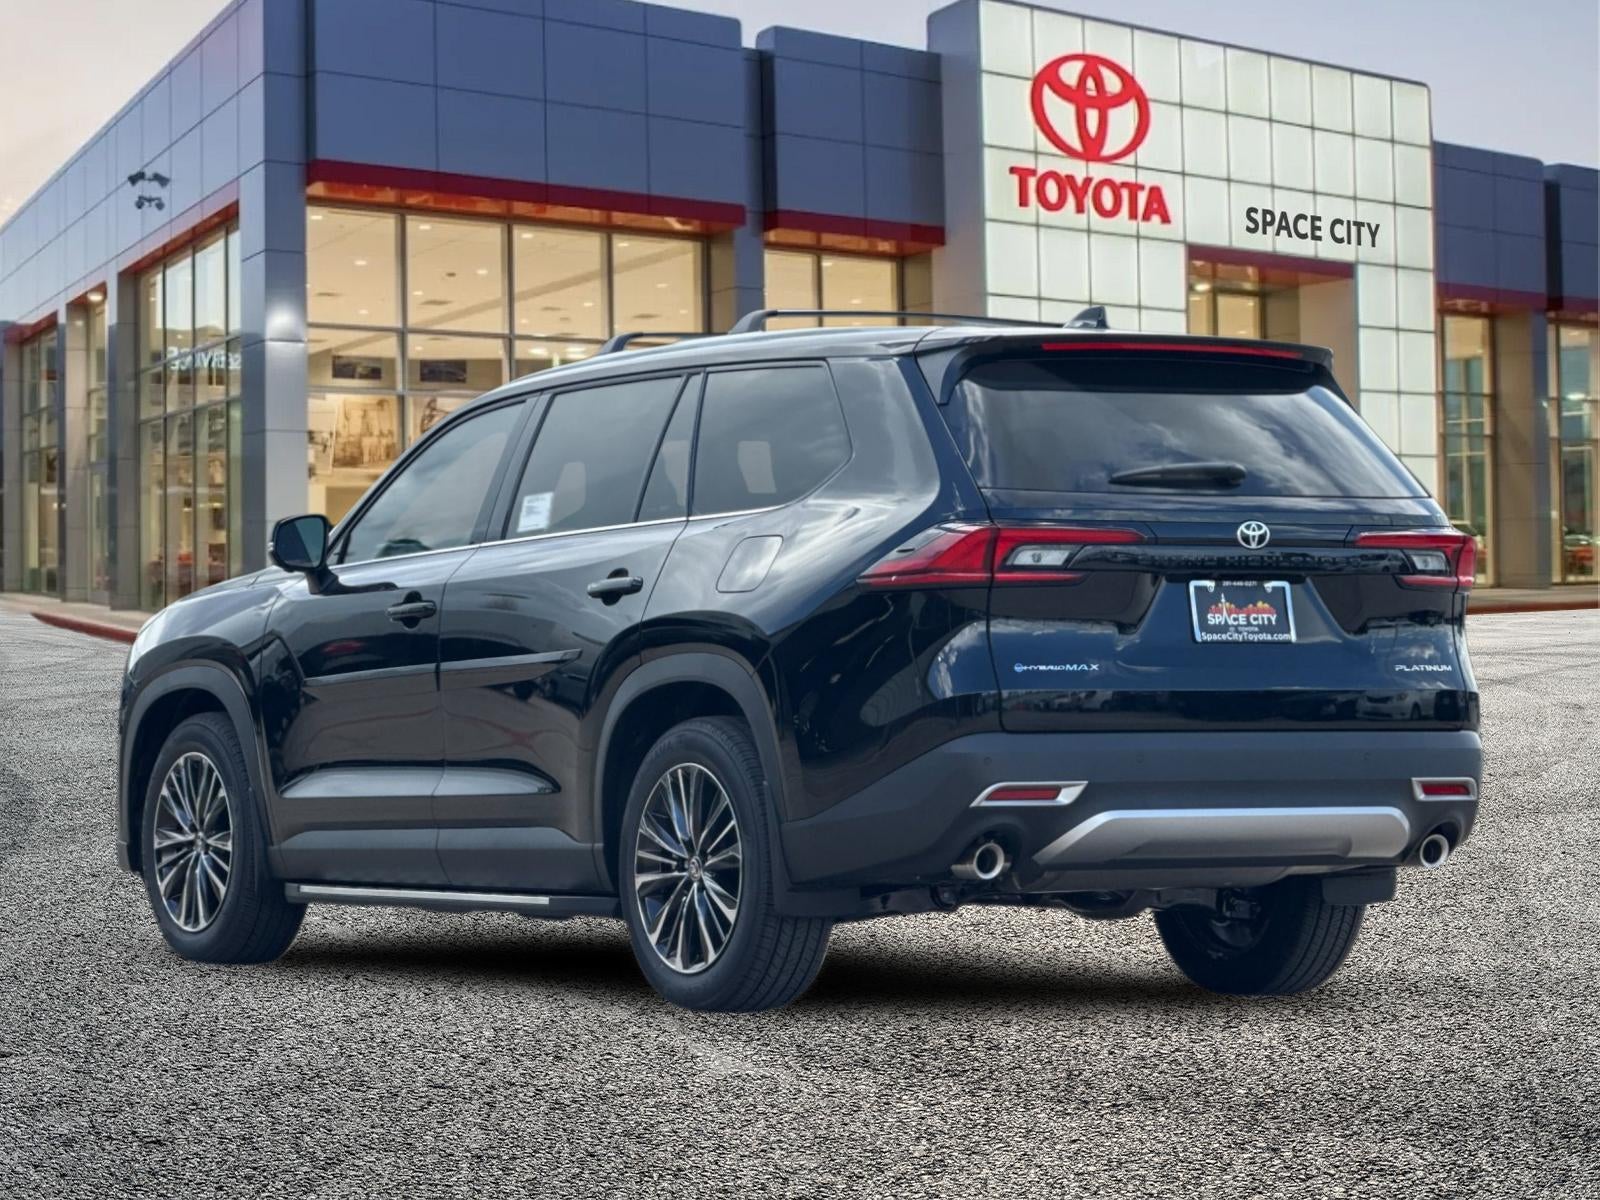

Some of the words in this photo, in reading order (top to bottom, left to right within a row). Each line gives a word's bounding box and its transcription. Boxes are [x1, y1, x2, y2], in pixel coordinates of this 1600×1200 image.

[1009, 166, 1172, 225] TOYOTA
[1245, 206, 1323, 242] SPACE
[1329, 218, 1381, 248] CITY
[1207, 613, 1247, 625] SPACE
[1249, 613, 1277, 625] CITY
[1201, 632, 1291, 642] SpaceCityToyota.com
[1394, 664, 1453, 672] PLATINUM
